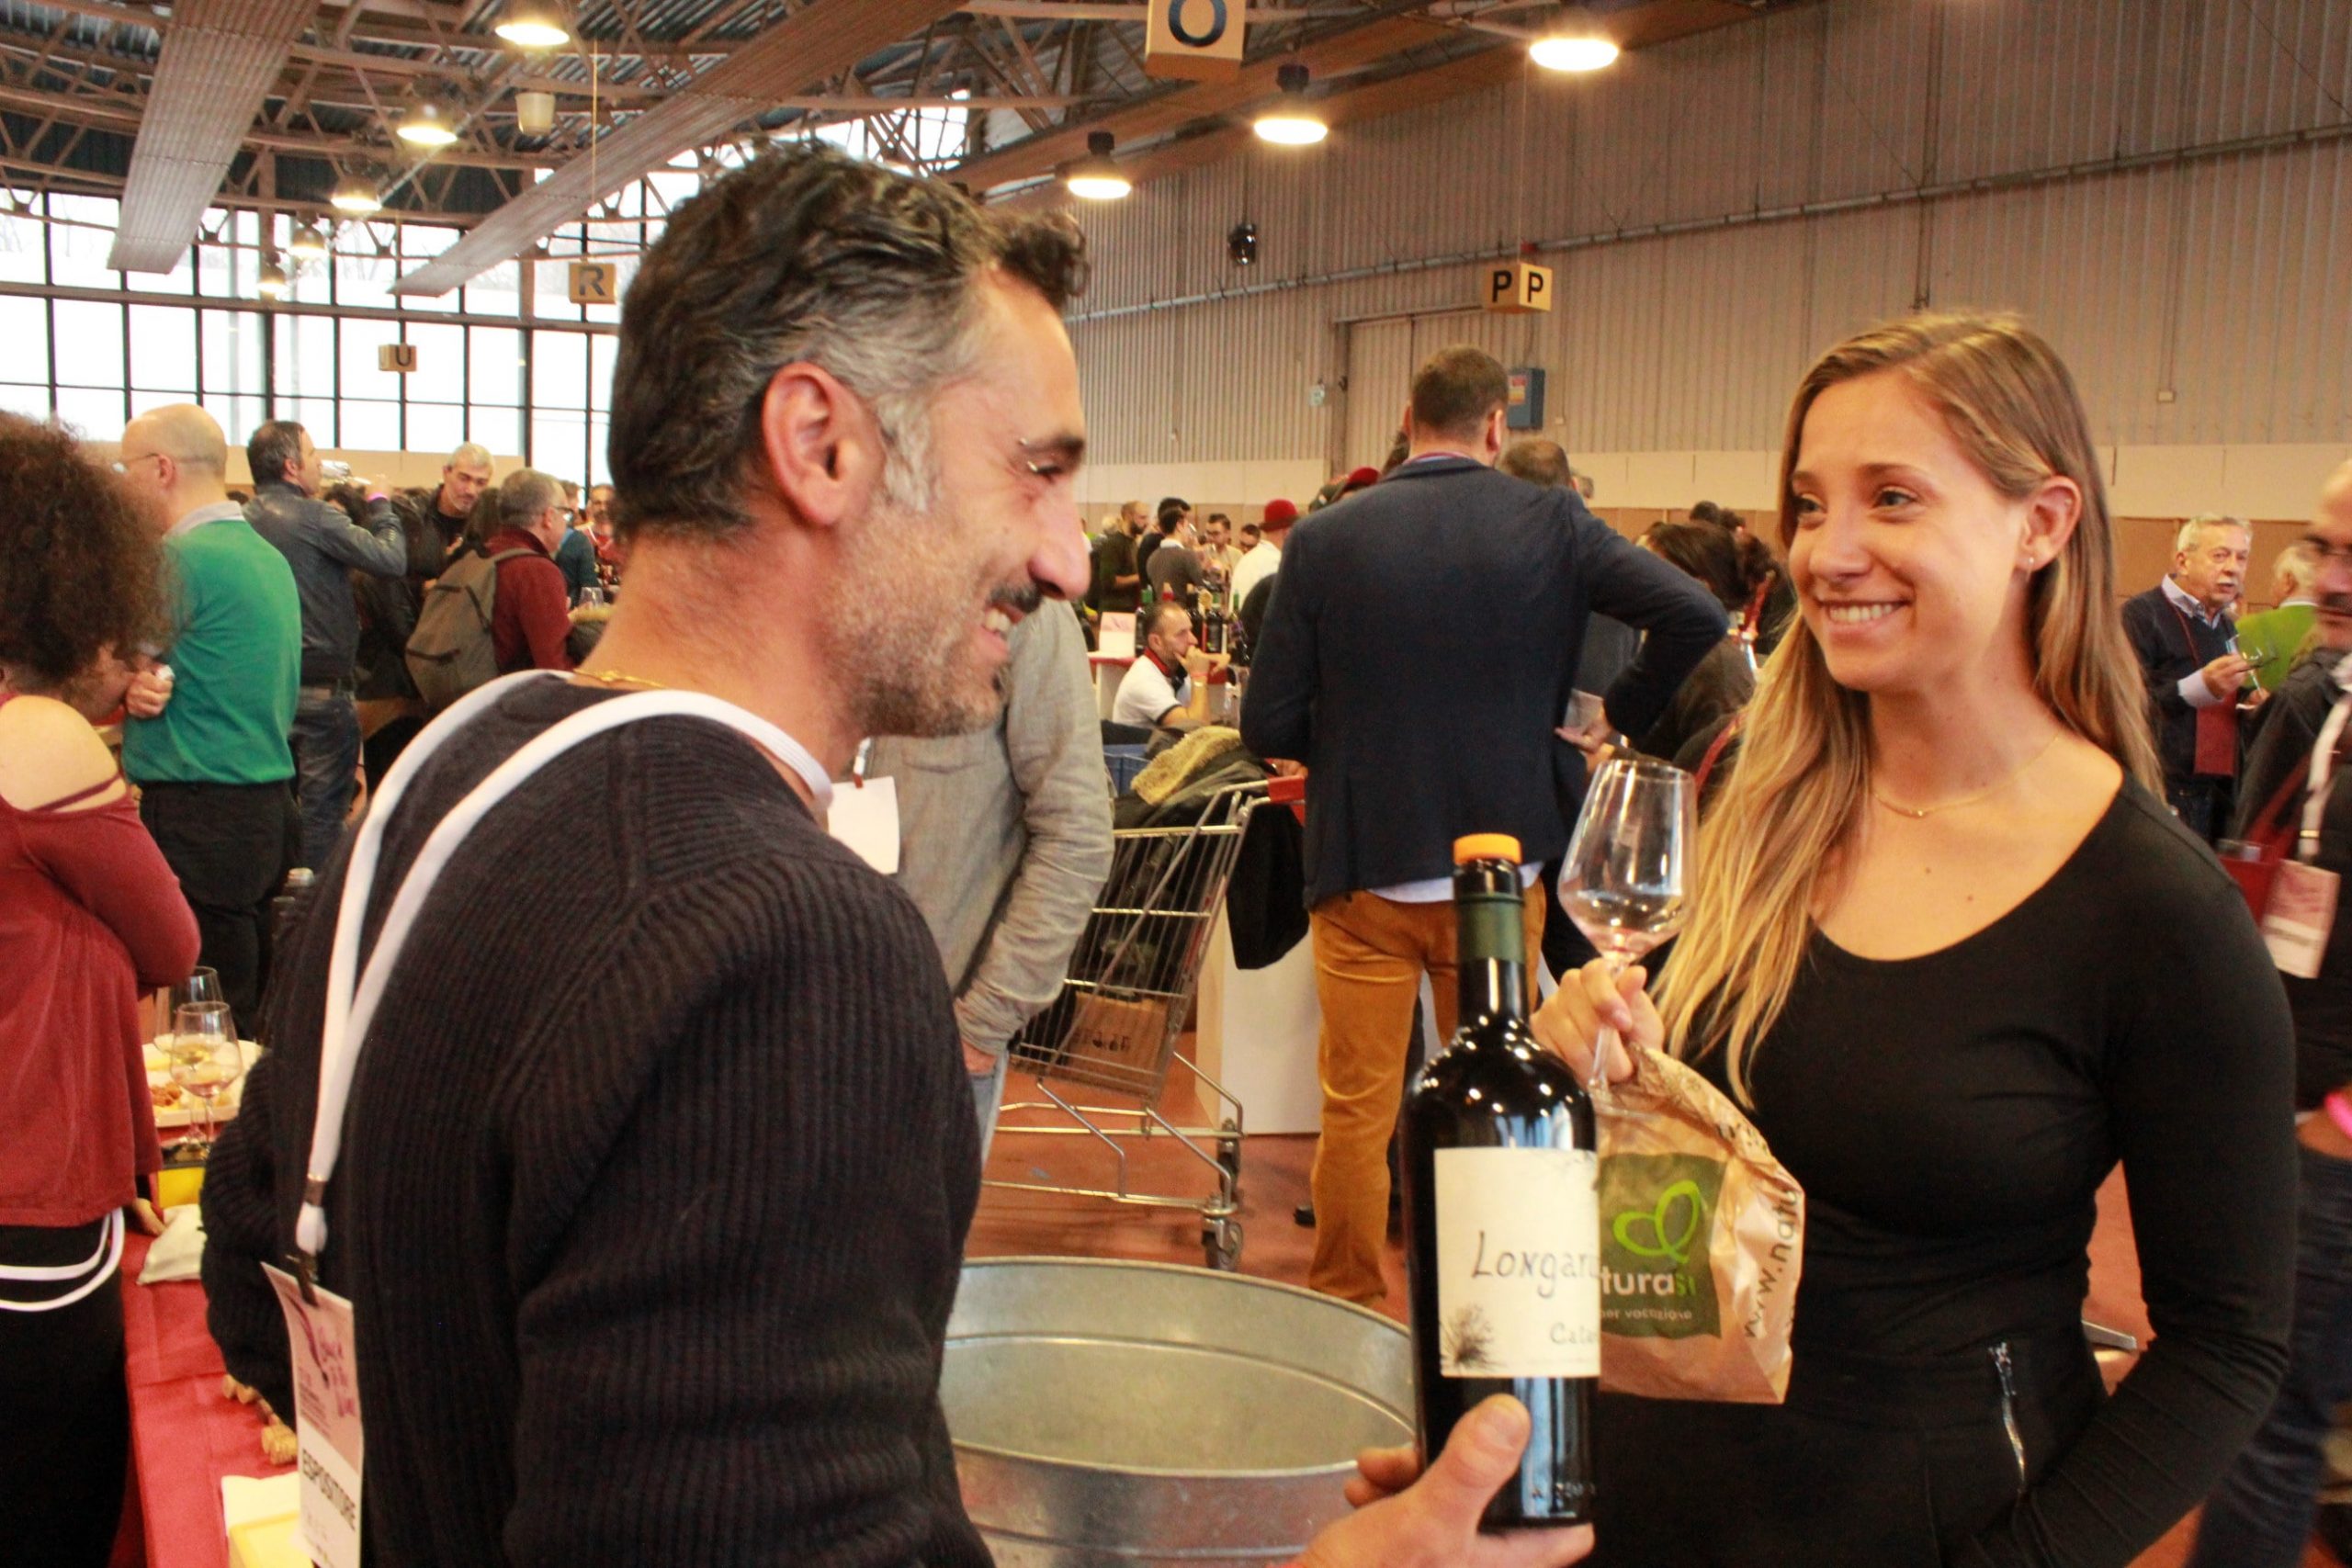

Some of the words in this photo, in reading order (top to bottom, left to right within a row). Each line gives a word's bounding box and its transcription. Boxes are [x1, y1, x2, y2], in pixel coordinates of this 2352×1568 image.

[1168, 0, 1227, 48] O
[579, 265, 605, 296] R
[1492, 270, 1512, 303] P
[1528, 271, 1544, 303] P
[395, 344, 413, 367] U
